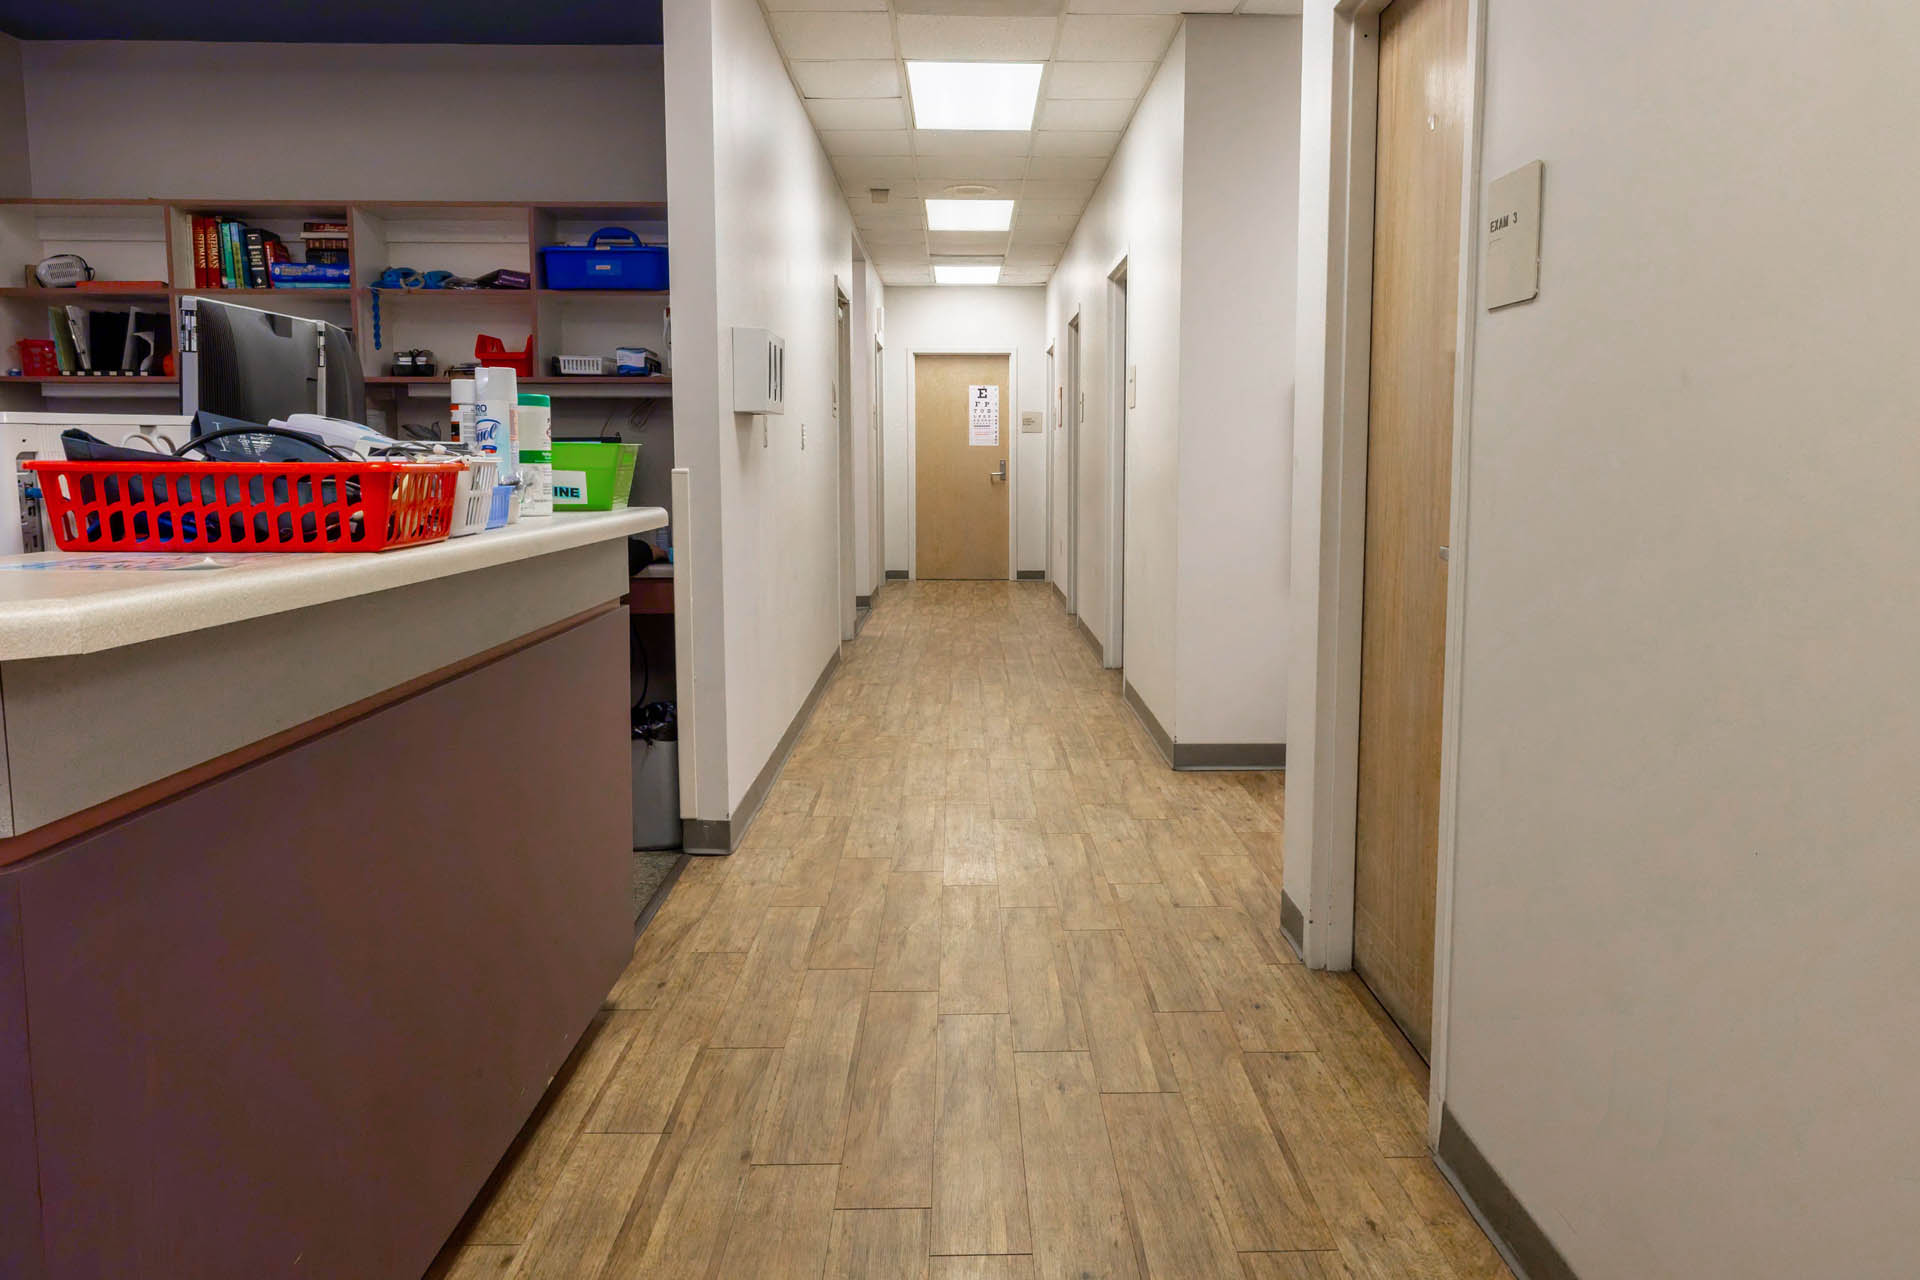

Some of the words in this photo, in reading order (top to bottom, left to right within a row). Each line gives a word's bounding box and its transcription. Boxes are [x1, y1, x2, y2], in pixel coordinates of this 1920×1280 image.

[1490, 214, 1509, 233] EXAM
[1513, 212, 1518, 224] 3
[977, 388, 987, 399] E
[475, 404, 487, 412] RO
[475, 423, 497, 445] sol
[554, 486, 580, 498] INE
